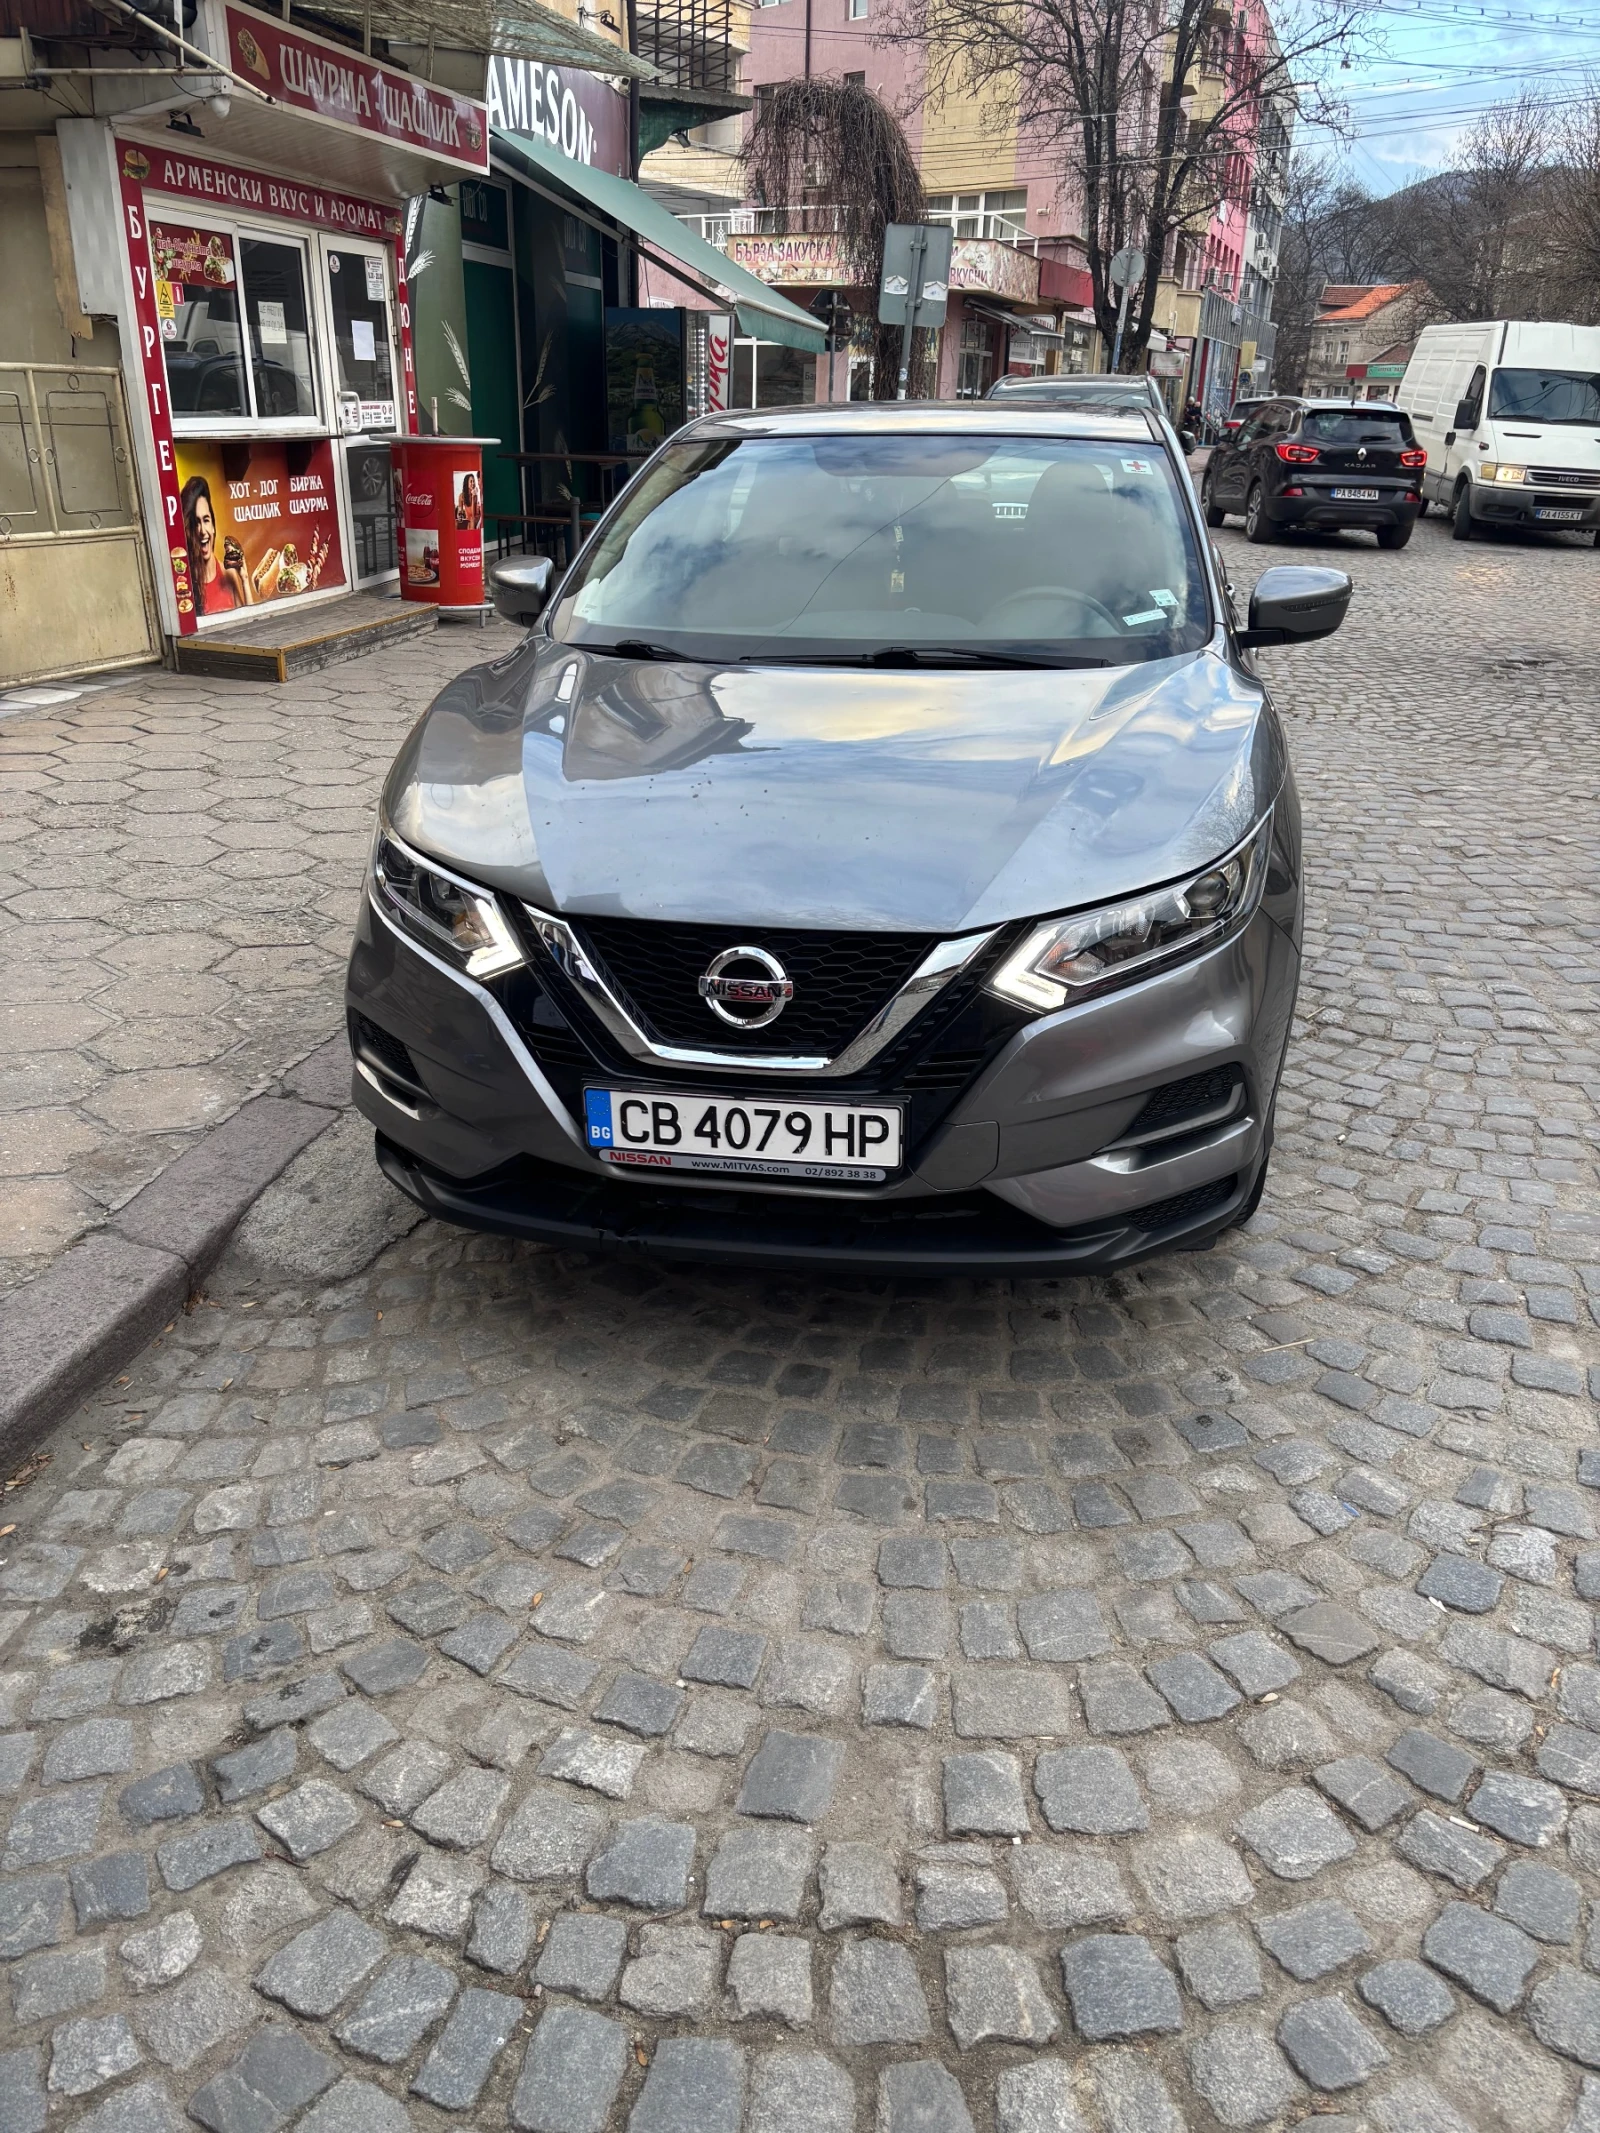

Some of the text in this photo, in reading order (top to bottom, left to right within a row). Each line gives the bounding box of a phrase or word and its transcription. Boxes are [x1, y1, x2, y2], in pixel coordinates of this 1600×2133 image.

[279, 43, 371, 118] ШАУРМА
[383, 84, 461, 148] ШАШЛИК
[487, 55, 594, 166] AMESON
[163, 159, 381, 230] АРМЕНСКИ ВКУС И АРОМАТ
[735, 242, 832, 262] БЪРЗА ЗАКУСКА
[950, 268, 987, 283] ВКУСНИ
[398, 257, 416, 414] ДЮНЕ
[127, 206, 177, 526] БУРГЕР
[229, 482, 250, 499] ХОТ
[260, 480, 278, 498] ДОГ
[290, 475, 324, 492] БИРЖА
[1336, 489, 1346, 498] PA
[1367, 490, 1377, 499] MA
[234, 497, 329, 522] ШАШЛИК ШАУРМА
[1551, 511, 1570, 519] 4155
[705, 982, 781, 998] NISSAN
[591, 1125, 611, 1139] BG
[620, 1099, 890, 1158] CB 4079 HP
[609, 1151, 672, 1166] NISSAN
[691, 1159, 790, 1174] www.MITVAS.com
[847, 1170, 860, 1179] 38
[862, 1171, 876, 1180] 38
